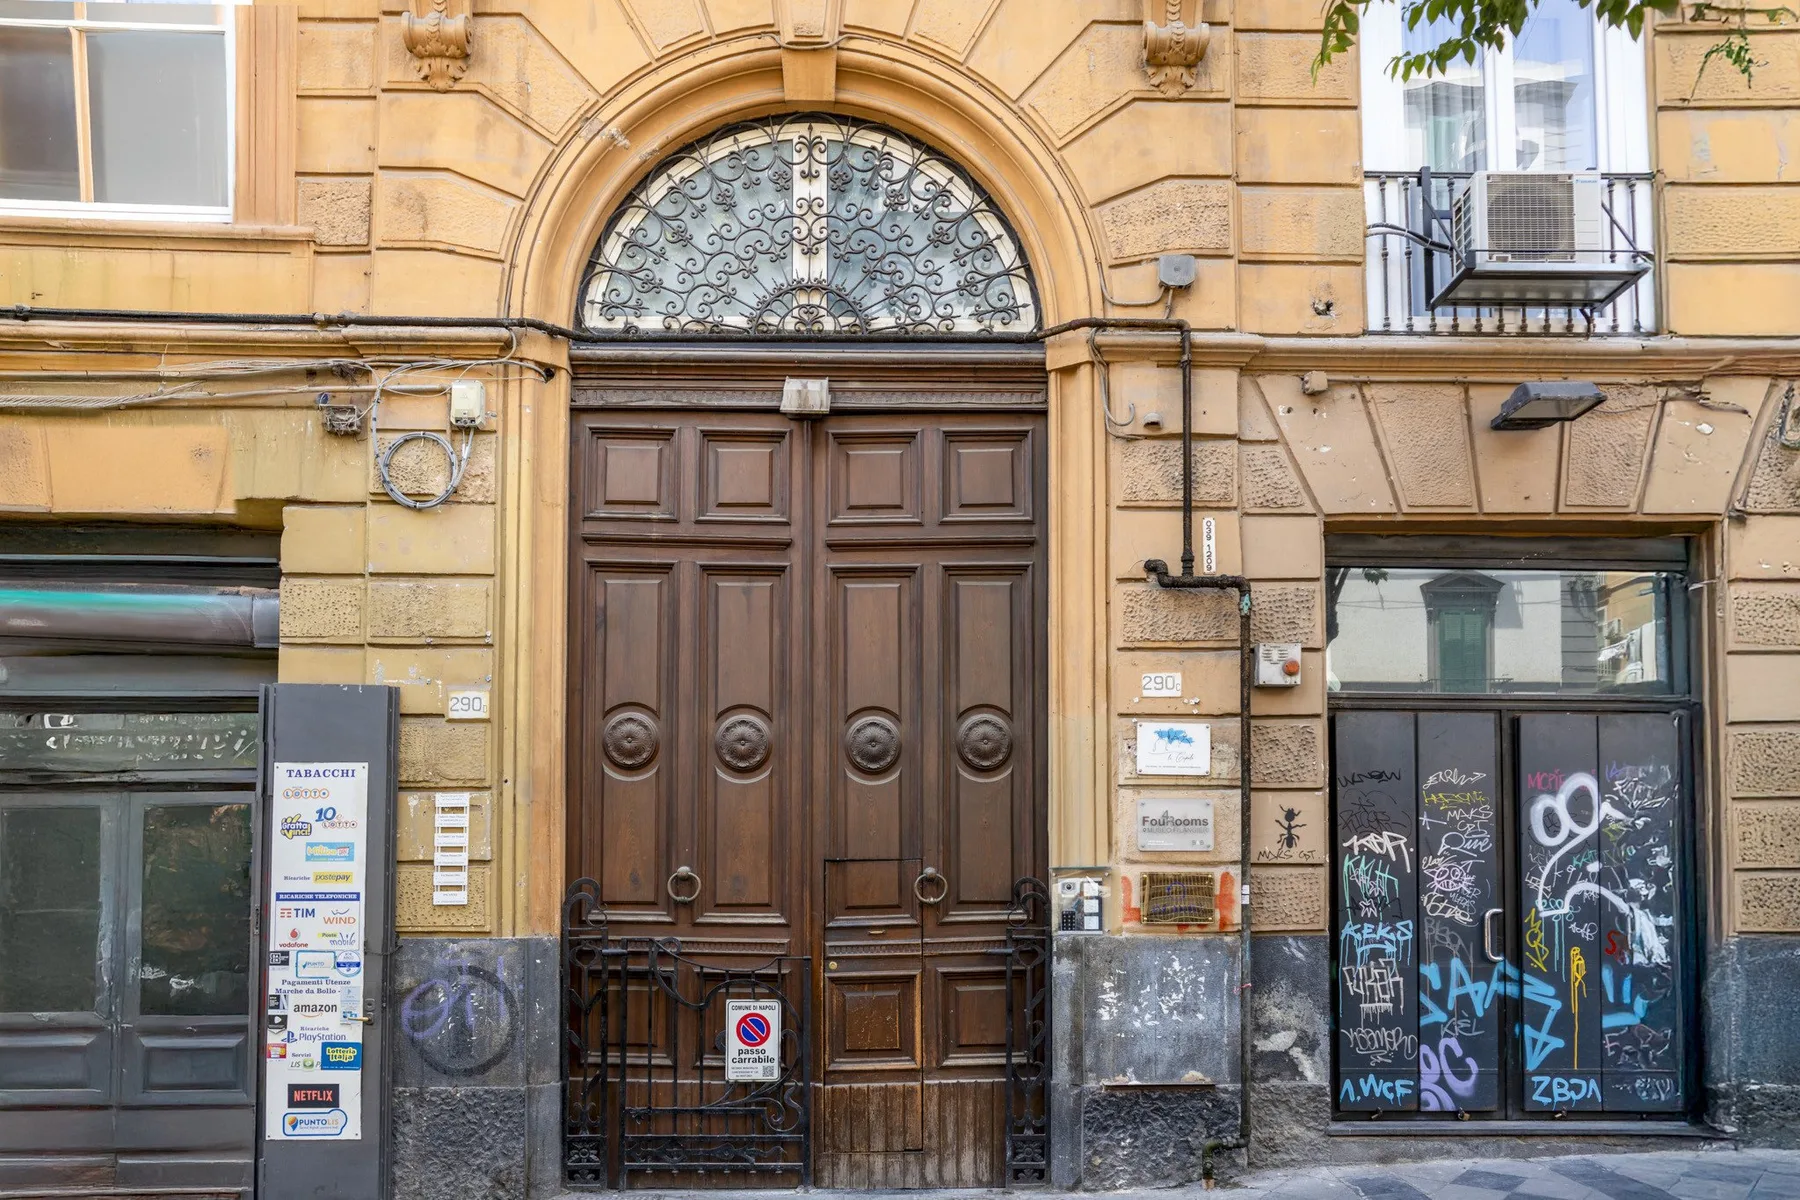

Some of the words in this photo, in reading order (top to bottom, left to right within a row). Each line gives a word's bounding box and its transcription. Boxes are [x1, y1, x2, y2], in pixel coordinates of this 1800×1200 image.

[286, 769, 356, 778] TABACCHI
[283, 788, 329, 799] LOTTO
[315, 874, 350, 882] postepay
[293, 908, 316, 918] TIM
[323, 916, 357, 925] WIND
[281, 979, 323, 987] Pagamenti
[293, 1004, 338, 1013] amazon
[299, 1032, 347, 1043] PlayStation
[738, 1048, 767, 1057] passo
[290, 1060, 301, 1068] LIS
[731, 1055, 776, 1064] carrabile
[293, 1090, 333, 1102] NETFLIX
